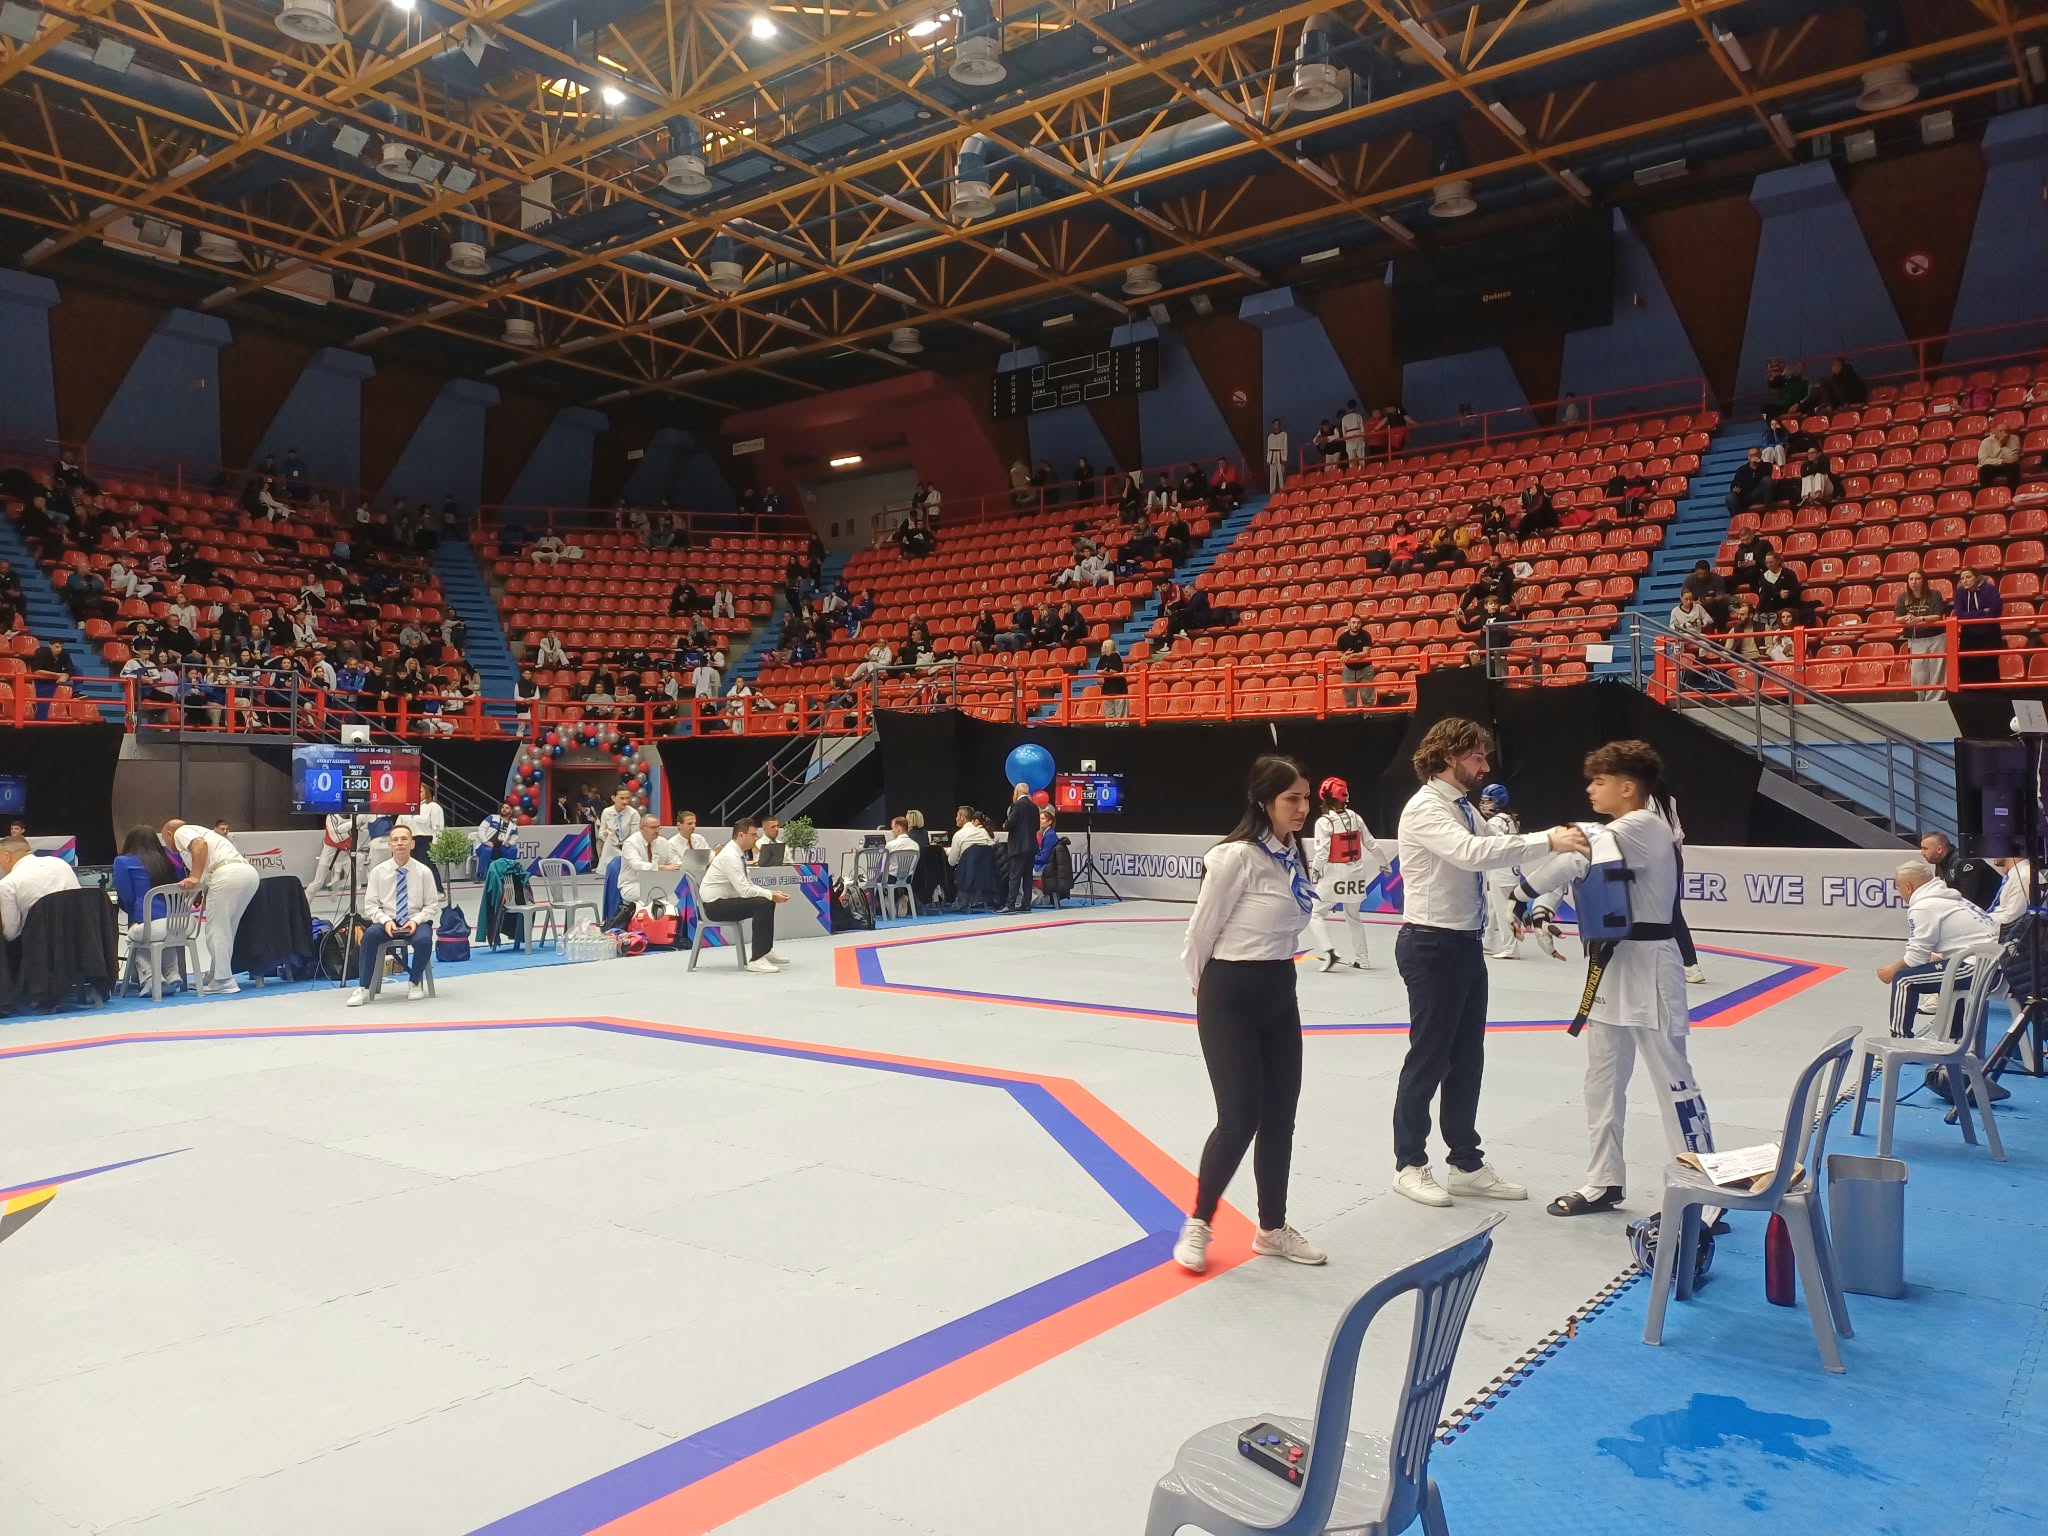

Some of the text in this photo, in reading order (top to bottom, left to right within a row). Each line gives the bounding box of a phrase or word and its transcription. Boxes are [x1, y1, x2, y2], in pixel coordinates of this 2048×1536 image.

[317, 772, 332, 792] 0
[344, 780, 369, 789] 1:30
[380, 773, 394, 793] 0
[4, 788, 12, 801] 0
[1068, 788, 1077, 800] 0
[1101, 788, 1110, 800] 0
[1099, 852, 1204, 880] TAEKWOND
[1333, 879, 1366, 895] GRE
[1743, 873, 1804, 905] WE
[1822, 876, 1911, 909] FIGH
